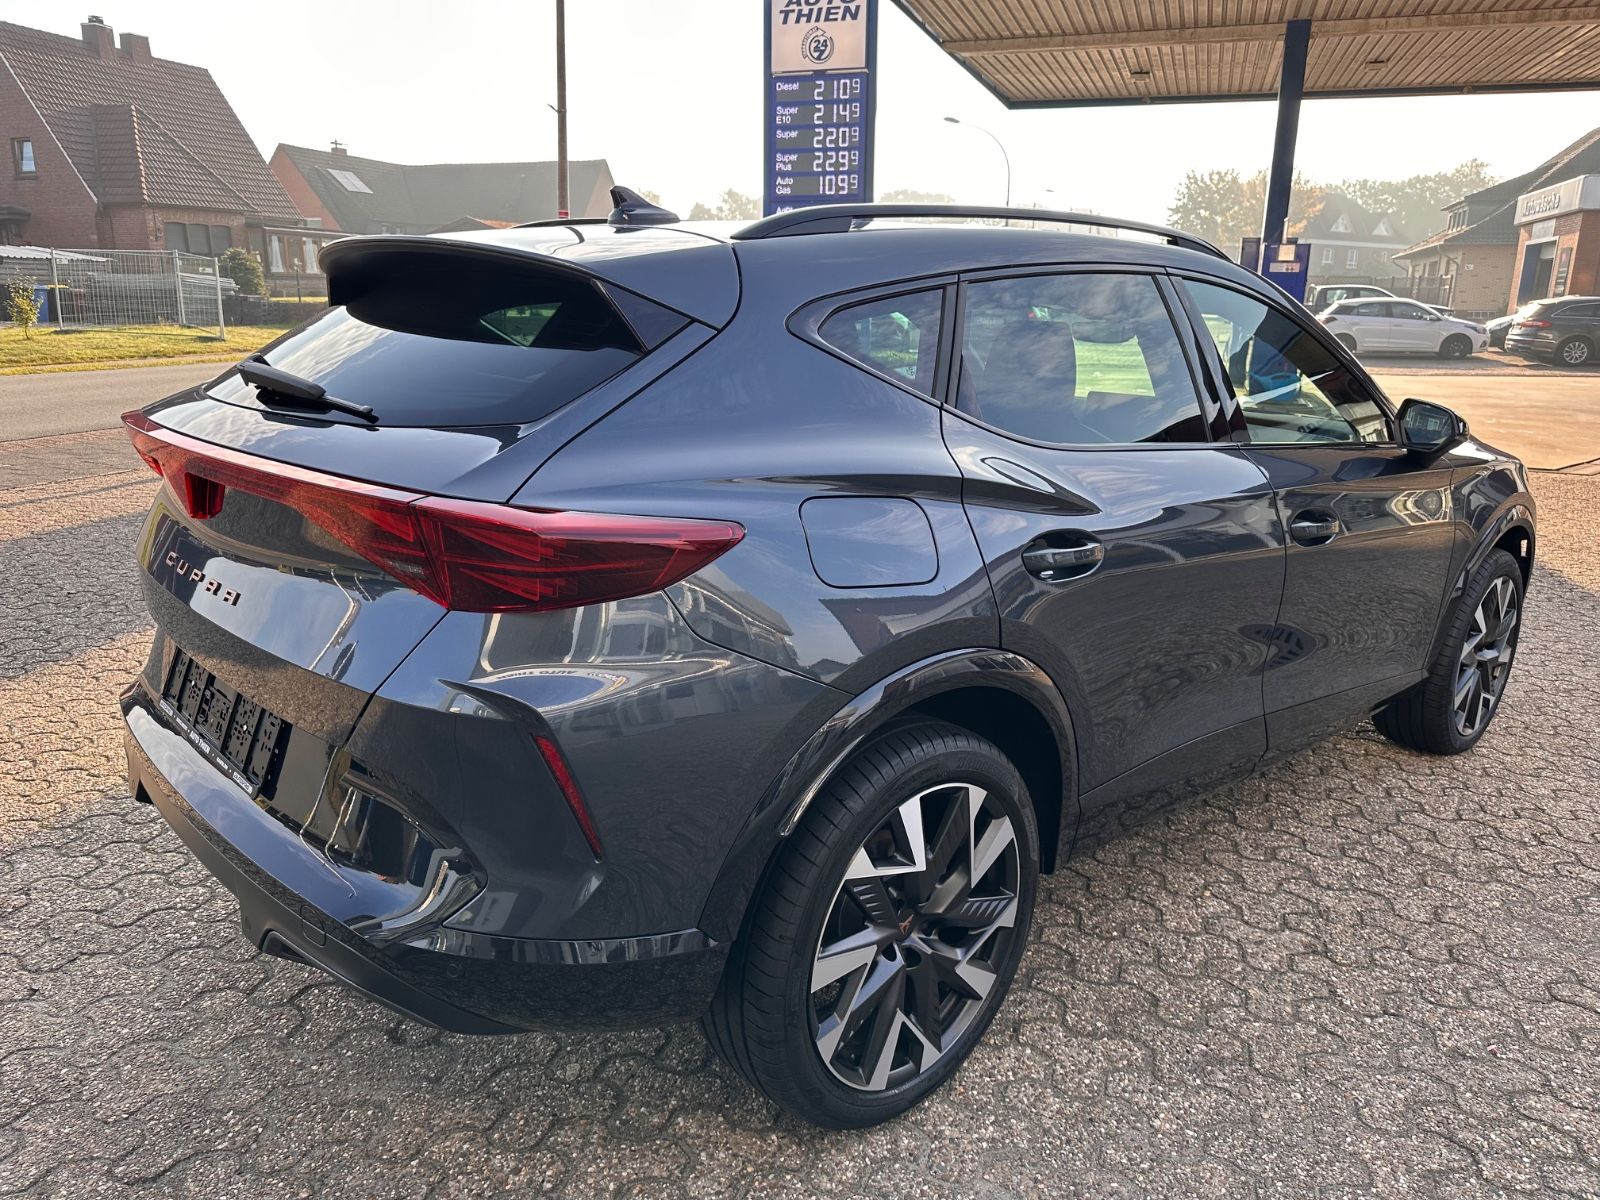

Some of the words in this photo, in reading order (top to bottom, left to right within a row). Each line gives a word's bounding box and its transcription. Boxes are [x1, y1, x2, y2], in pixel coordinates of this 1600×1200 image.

[784, 0, 851, 8] AU
[779, 5, 861, 25] THIEN
[813, 39, 829, 50] 24
[776, 82, 799, 92] Diesel
[776, 106, 799, 117] Super
[776, 116, 791, 124] E10
[776, 130, 798, 141] Super
[776, 153, 798, 164] Super
[776, 163, 792, 172] Plus
[776, 177, 793, 186] Auto
[776, 186, 791, 195] Gas
[165, 551, 241, 607] CUPRA
